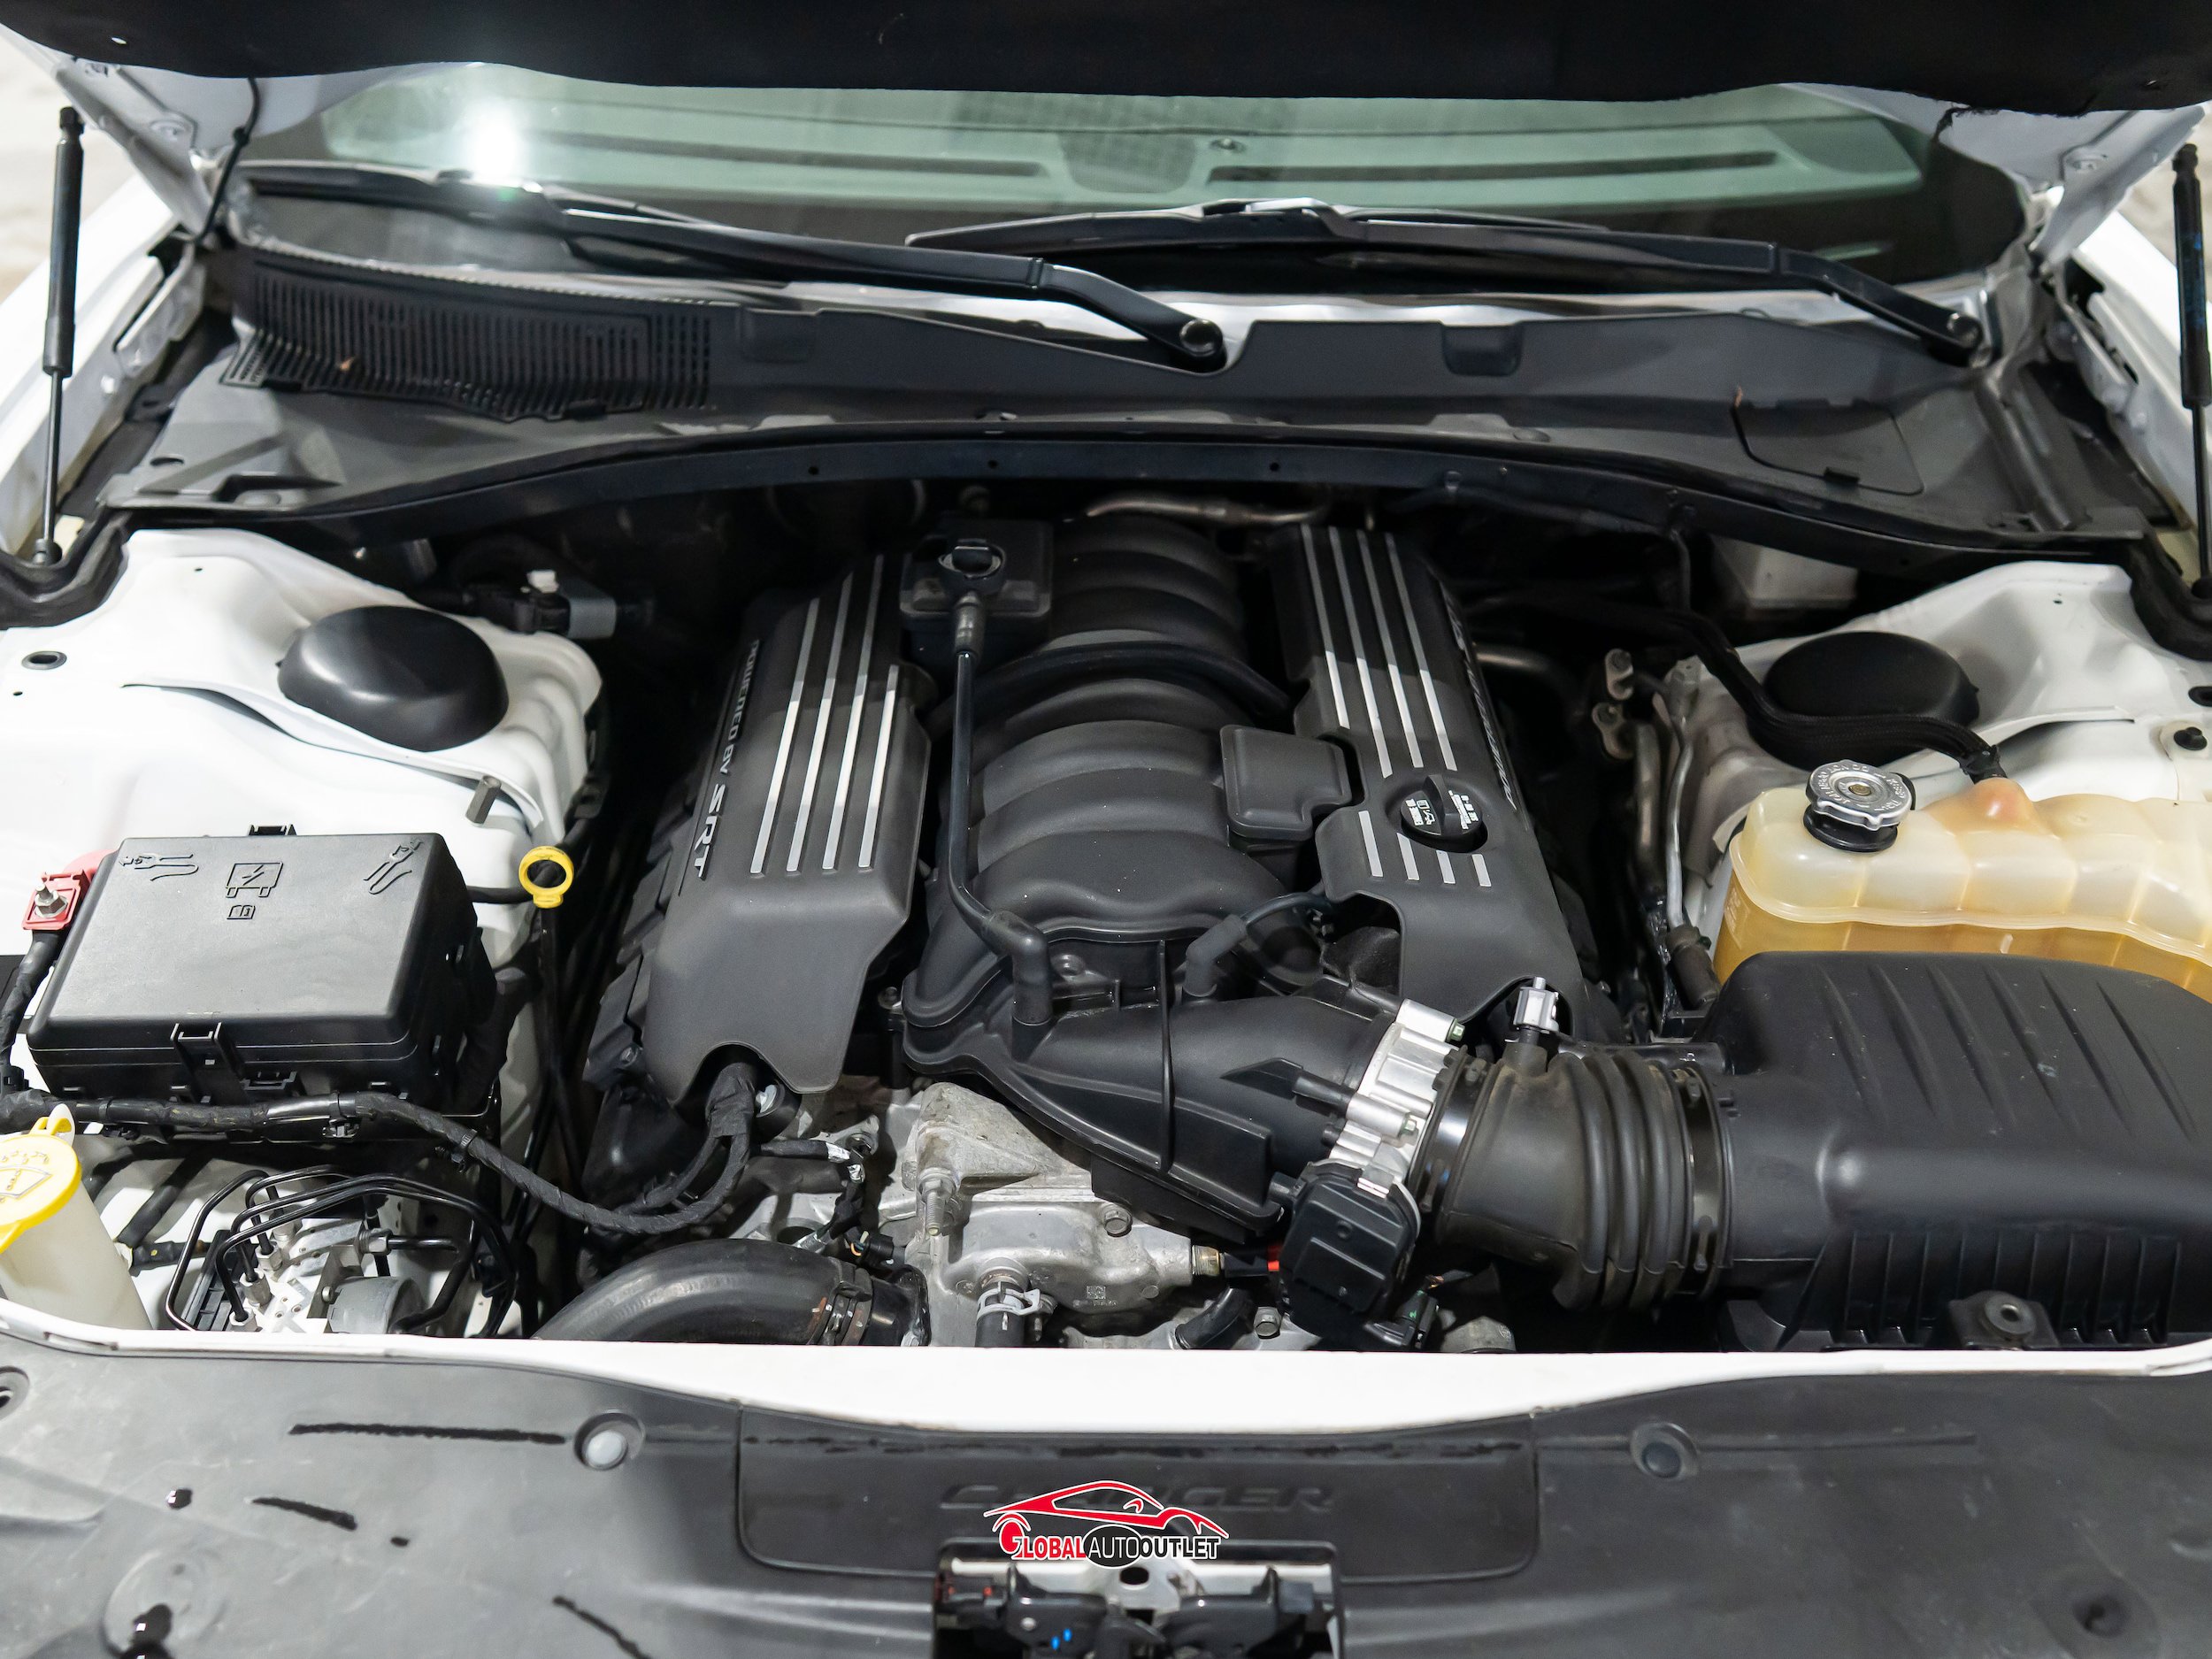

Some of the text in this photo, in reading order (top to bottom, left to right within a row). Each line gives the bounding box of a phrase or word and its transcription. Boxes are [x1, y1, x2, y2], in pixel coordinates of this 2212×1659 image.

[694, 639, 758, 878] POWERED BY SRT
[939, 1483, 1332, 1513] CGER
